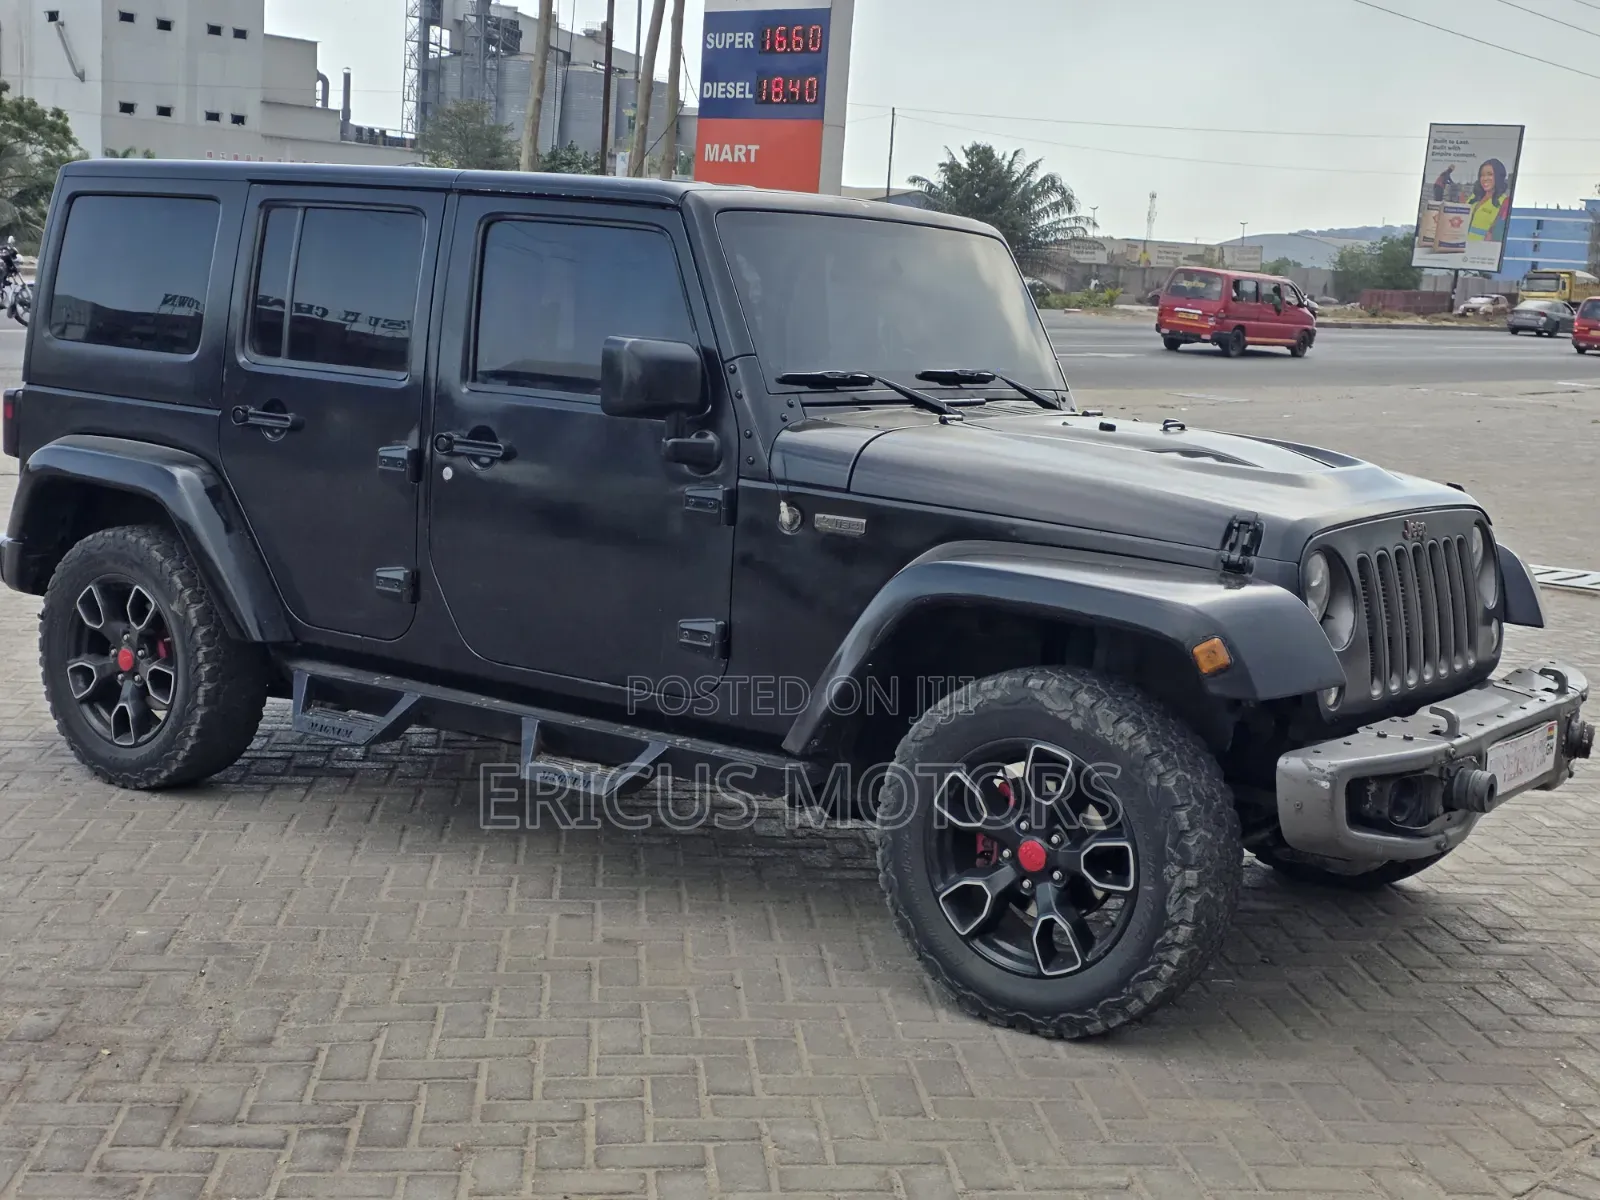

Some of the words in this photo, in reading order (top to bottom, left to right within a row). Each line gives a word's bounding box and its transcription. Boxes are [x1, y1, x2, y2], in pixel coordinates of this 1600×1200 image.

[706, 31, 754, 50] SUPER
[764, 24, 822, 52] 16.60
[702, 81, 754, 100] DIESEL
[760, 76, 818, 103] 18.40
[704, 143, 760, 163] MART
